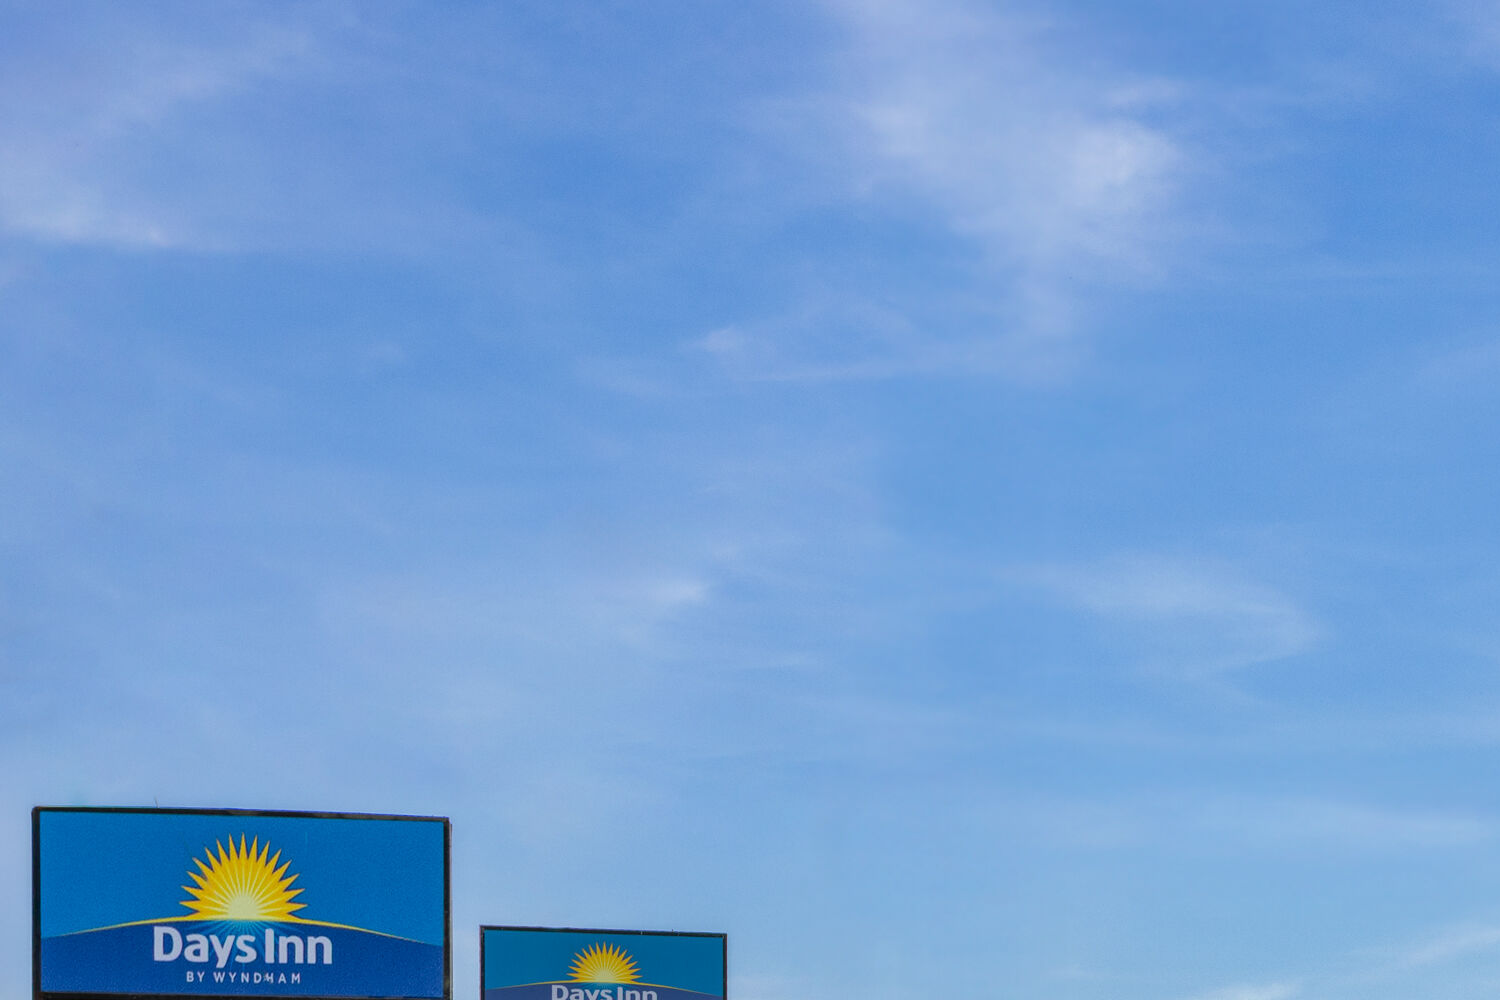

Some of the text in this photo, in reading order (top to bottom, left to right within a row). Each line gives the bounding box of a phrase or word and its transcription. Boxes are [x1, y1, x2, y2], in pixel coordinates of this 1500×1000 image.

[153, 926, 333, 969] Days Inn
[186, 971, 301, 984] BY WYNDHAM
